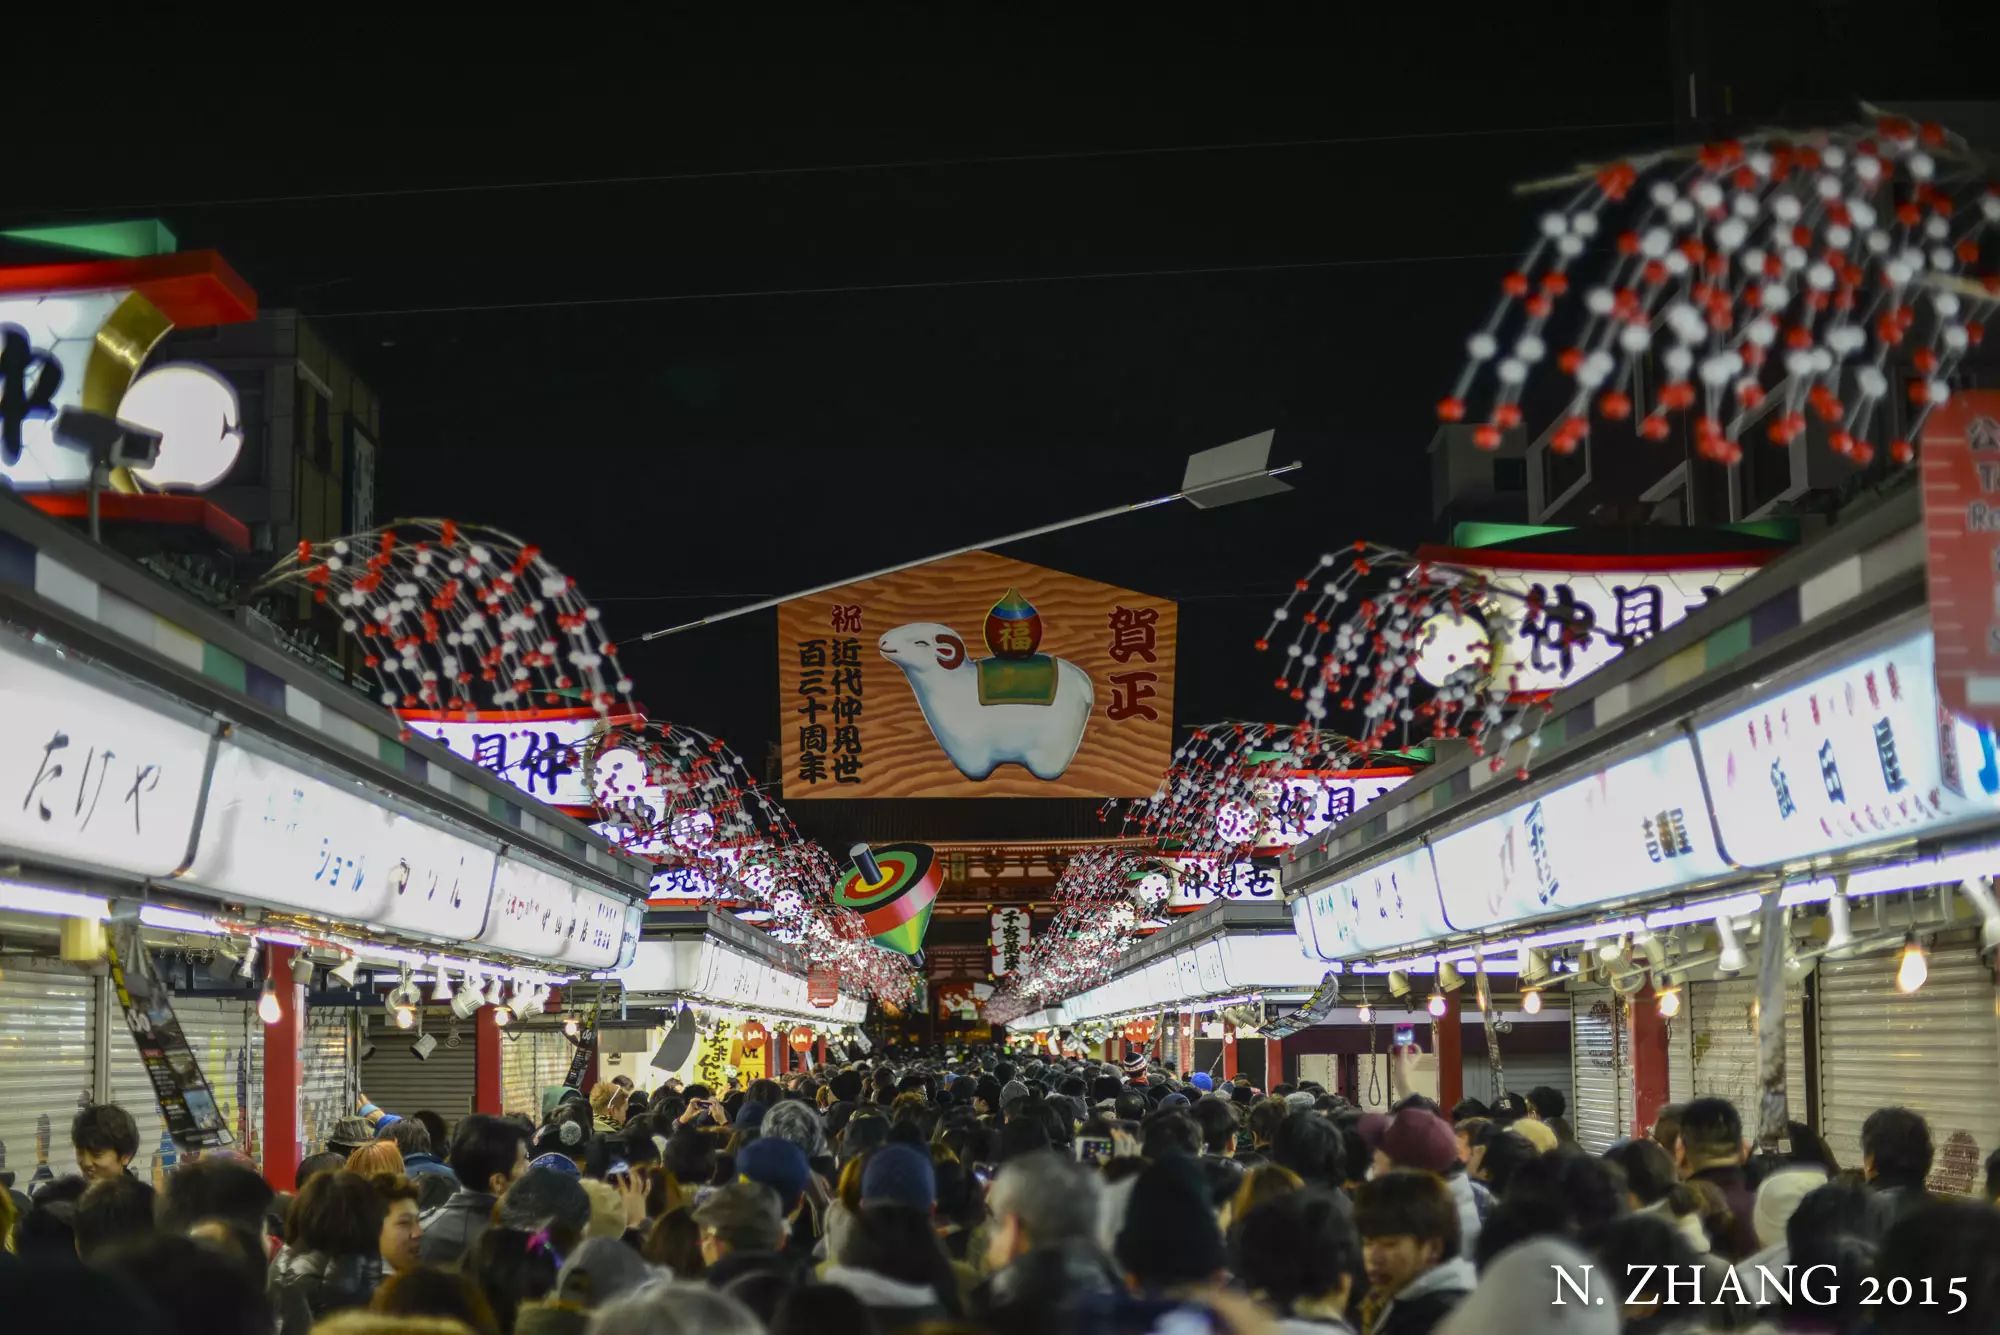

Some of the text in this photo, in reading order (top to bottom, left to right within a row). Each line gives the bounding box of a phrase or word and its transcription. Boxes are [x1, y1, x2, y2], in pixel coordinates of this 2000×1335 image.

[999, 621, 1033, 651] 福
[1106, 606, 1161, 722] 賀正
[1521, 583, 1722, 679] 仲見
[797, 639, 827, 785] 百三十周年
[831, 604, 863, 785] 祝 近代仲見世
[23, 729, 162, 835] たけや
